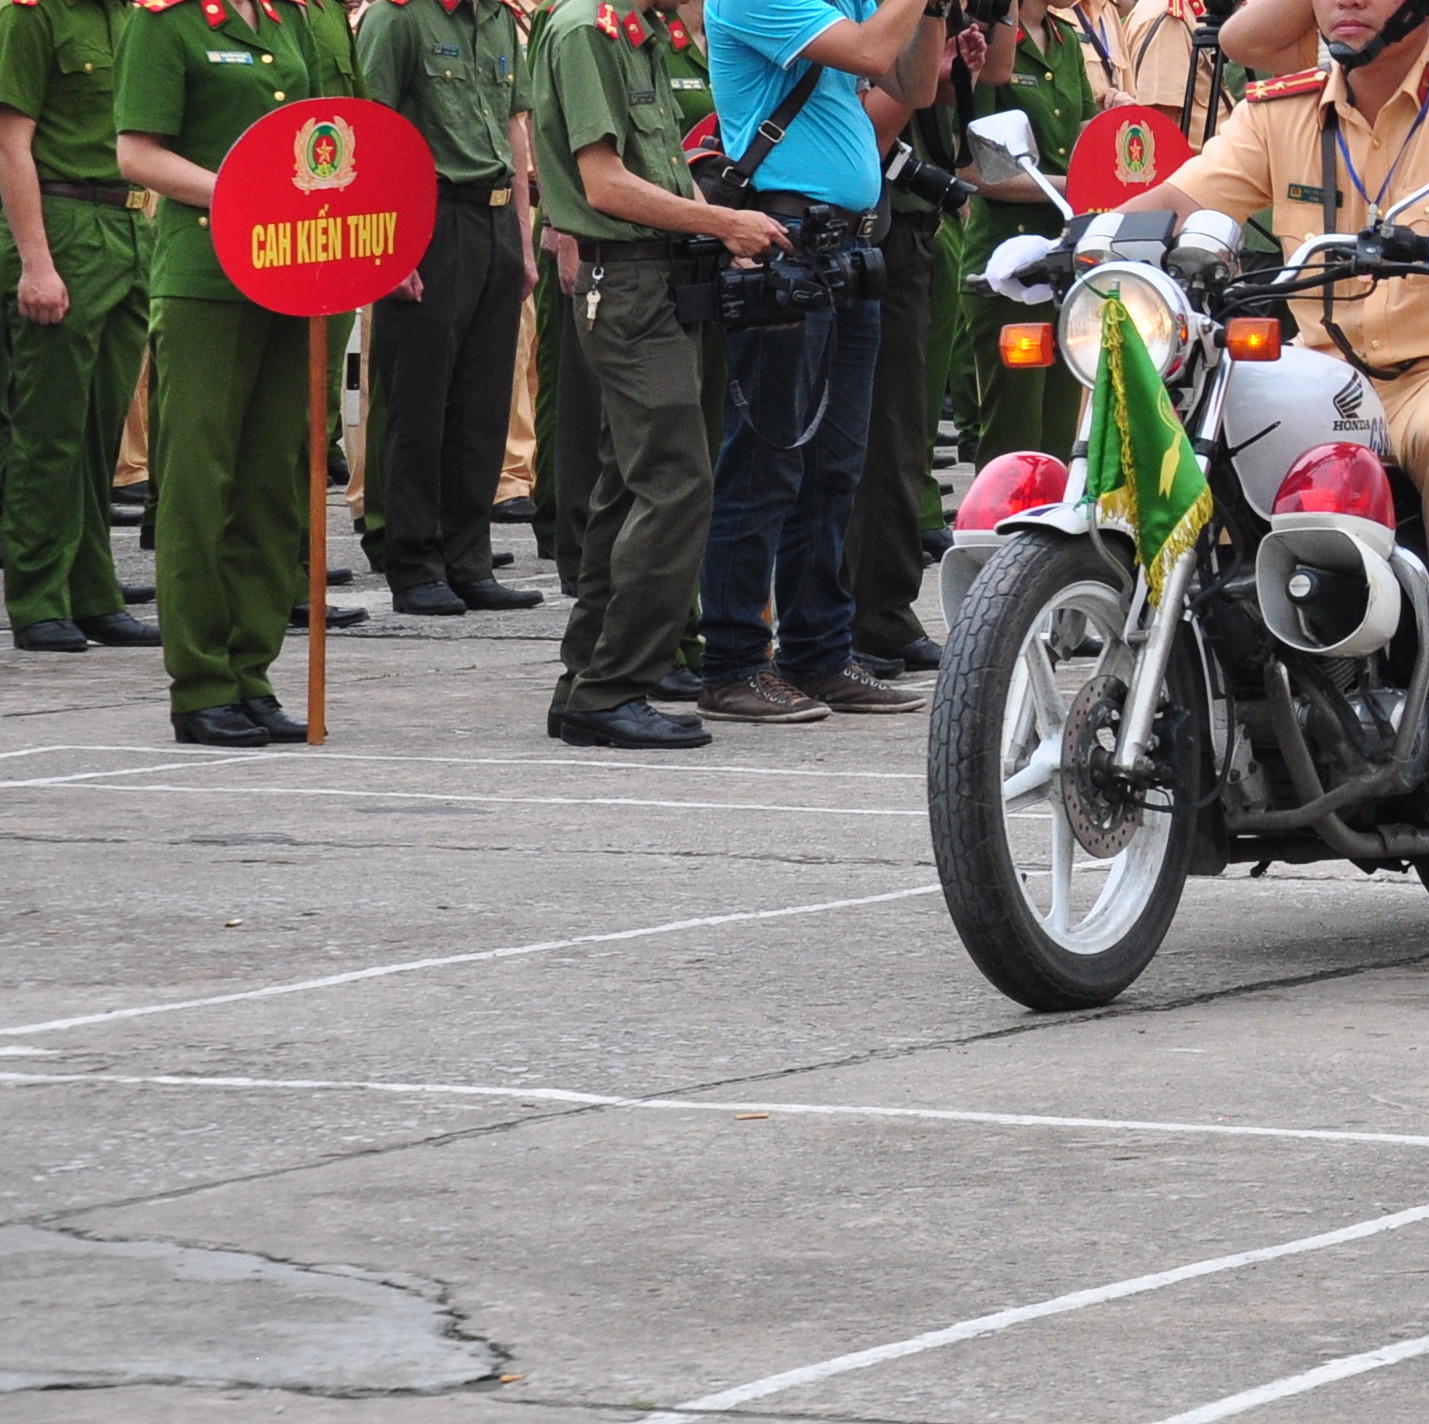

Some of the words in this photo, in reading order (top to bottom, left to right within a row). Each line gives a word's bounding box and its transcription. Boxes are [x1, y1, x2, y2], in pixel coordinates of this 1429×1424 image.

[252, 222, 291, 269] CAH
[297, 204, 342, 264] KIẾN
[347, 212, 397, 266] THỤY
[1332, 419, 1371, 431] HONDA
